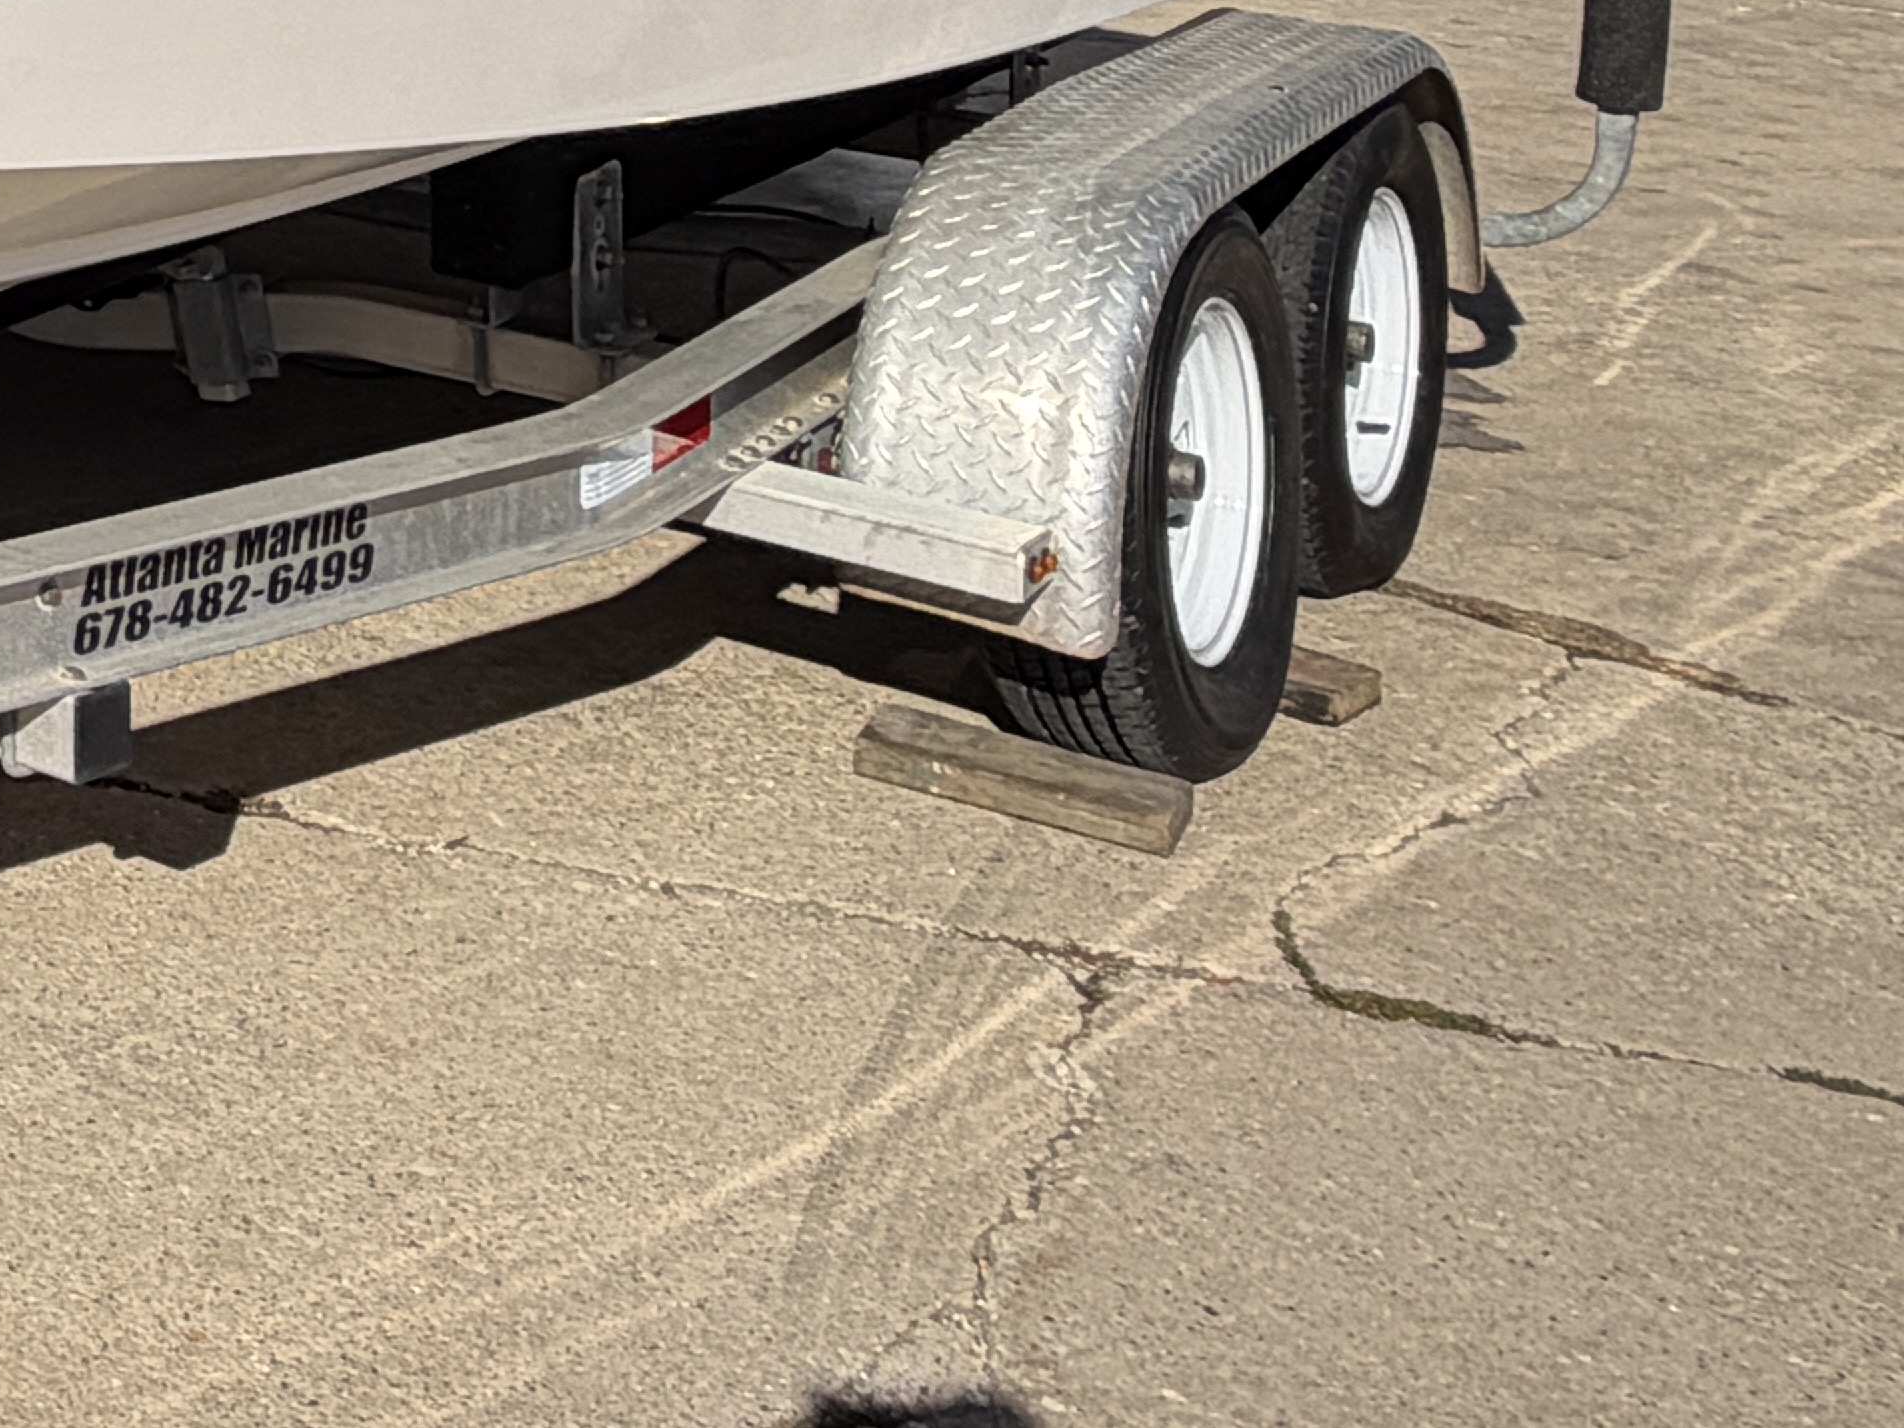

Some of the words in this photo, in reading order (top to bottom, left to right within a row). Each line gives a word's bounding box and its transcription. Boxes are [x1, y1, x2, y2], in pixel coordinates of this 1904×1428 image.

[74, 542, 374, 656] 678-482-6499
[80, 536, 228, 608] Atlanta
[233, 502, 368, 570] Marine
